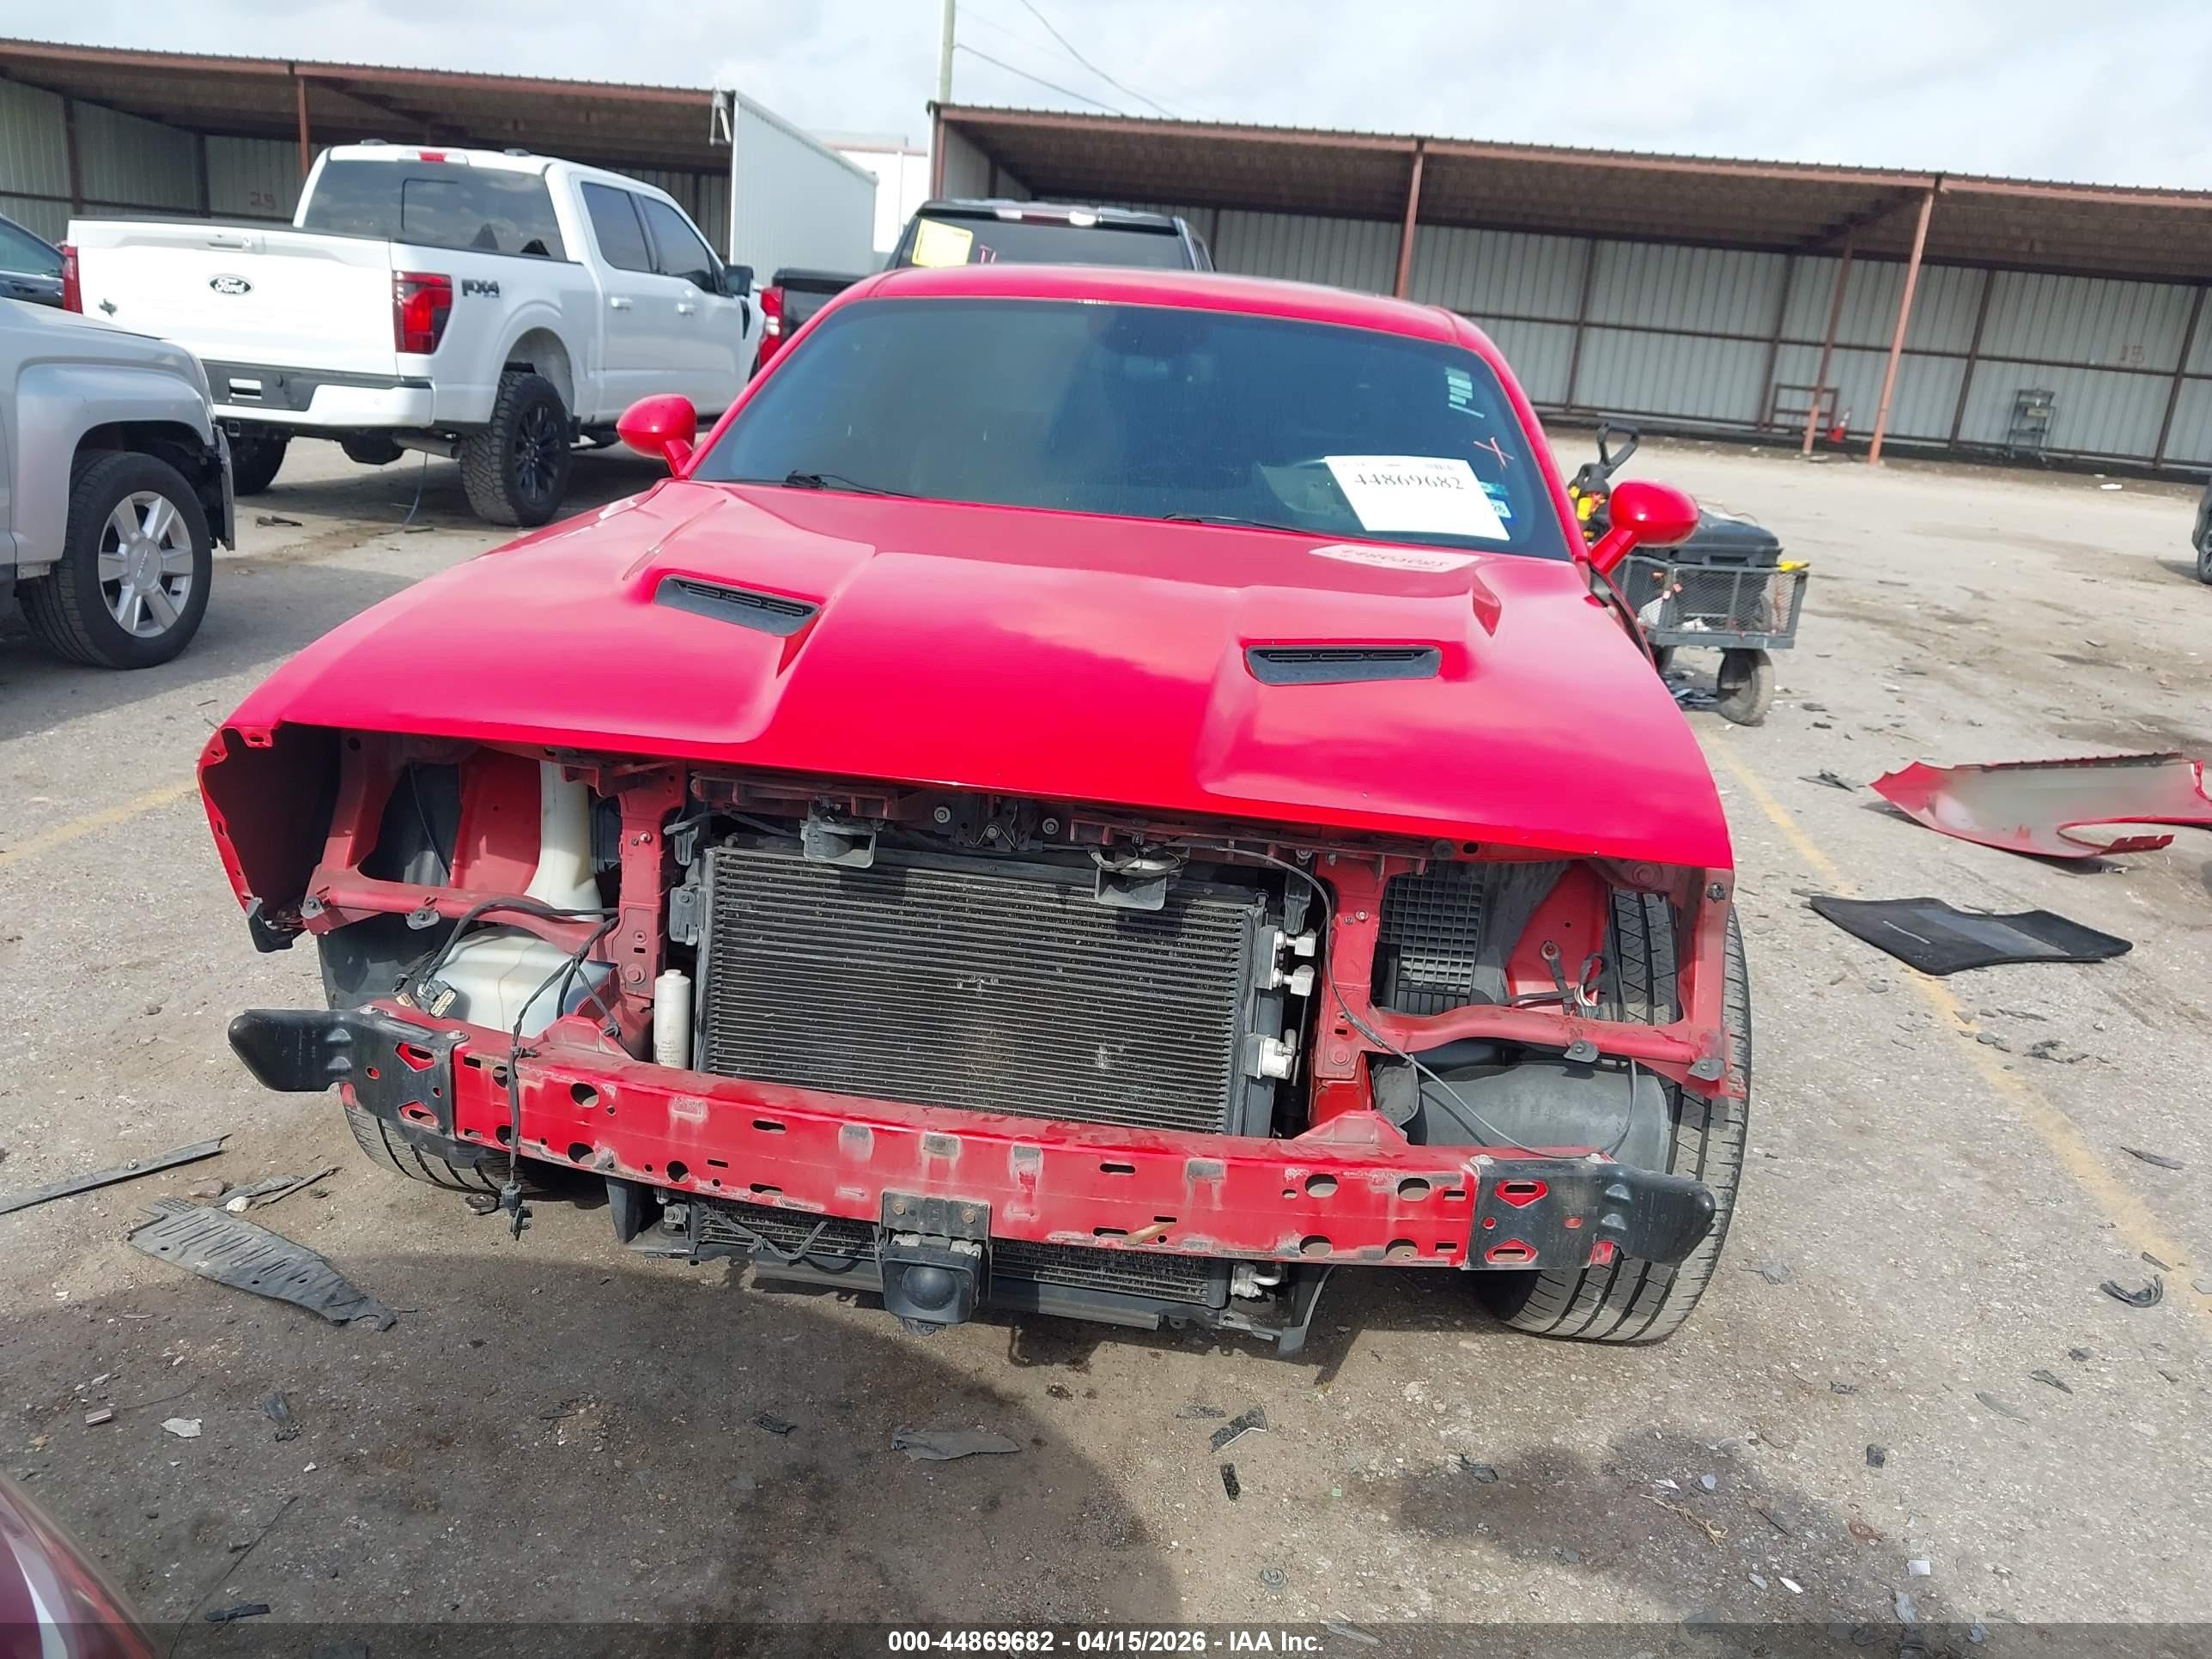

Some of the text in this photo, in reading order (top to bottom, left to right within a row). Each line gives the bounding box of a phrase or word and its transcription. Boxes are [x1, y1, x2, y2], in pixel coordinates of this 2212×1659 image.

[214, 276, 246, 295] Ford
[461, 279, 500, 296] FX4
[1353, 473, 1465, 490] 44869682
